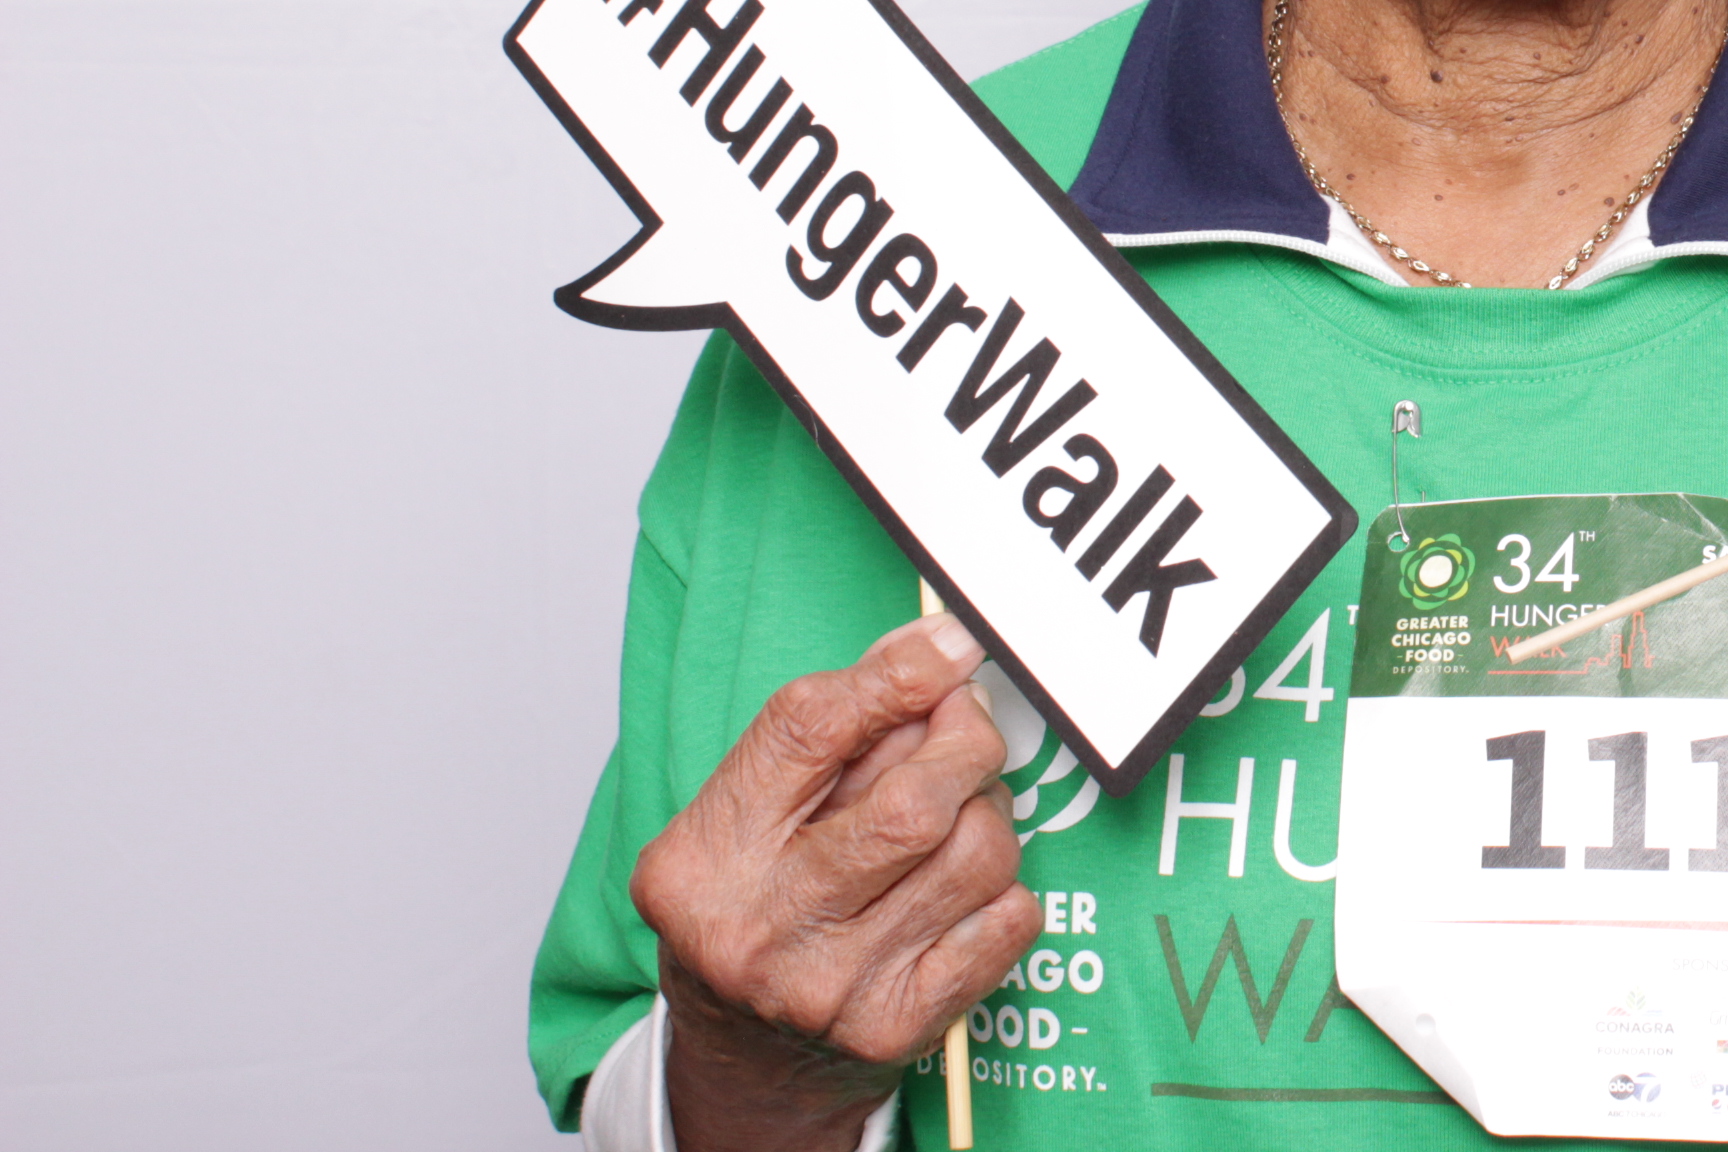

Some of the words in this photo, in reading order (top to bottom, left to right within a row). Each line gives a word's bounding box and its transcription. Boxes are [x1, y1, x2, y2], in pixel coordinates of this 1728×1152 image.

[1396, 615, 1469, 631] GREATER
[1391, 631, 1472, 647] CHICAGO
[1034, 891, 1097, 935] ER
[1595, 1021, 1675, 1034] CONAGRA
[1597, 1047, 1674, 1057] FOUNDATION
[1608, 1080, 1635, 1093] abc
[1607, 1110, 1625, 1118] ABC
